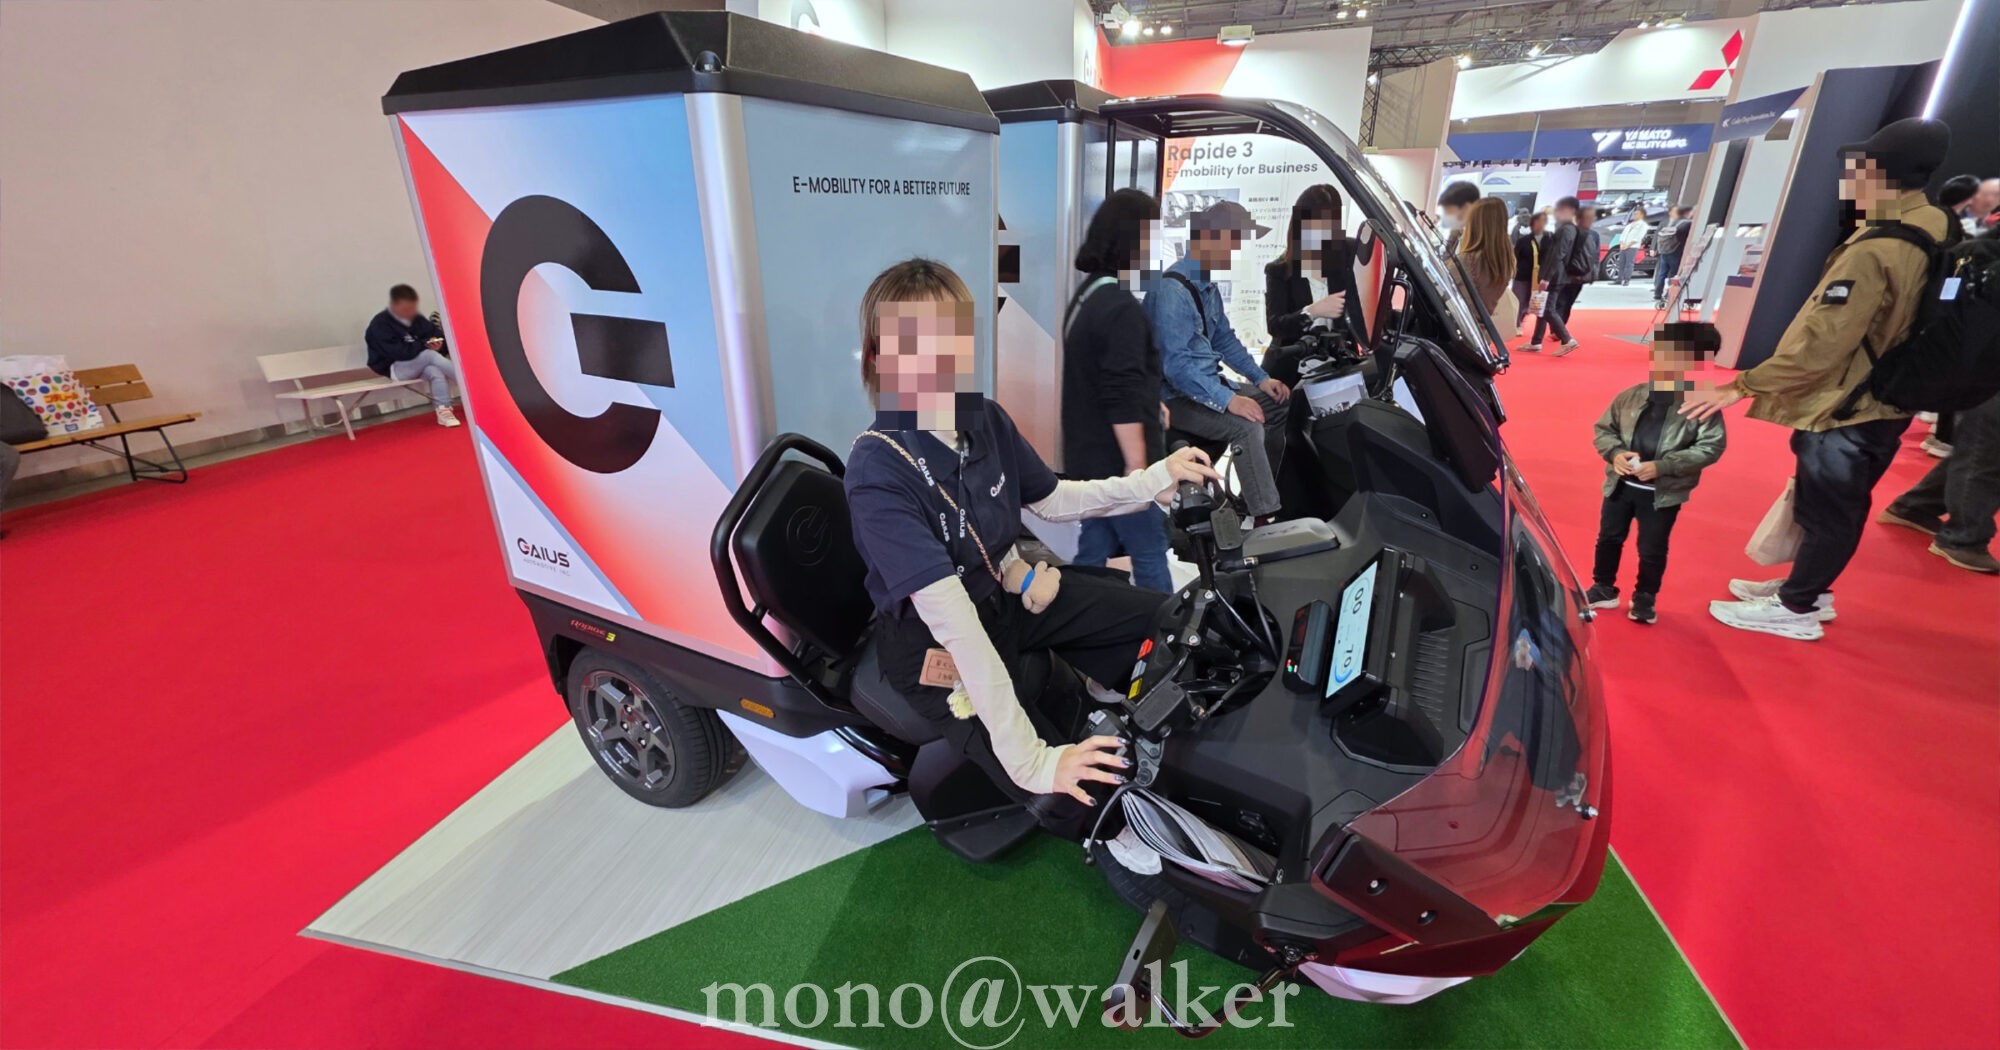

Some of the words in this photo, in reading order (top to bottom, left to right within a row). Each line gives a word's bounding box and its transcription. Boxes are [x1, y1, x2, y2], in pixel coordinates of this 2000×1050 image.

[1624, 128, 1672, 141] YAMATO
[1167, 142, 1236, 165] Rapide
[1242, 141, 1253, 157] 3
[1166, 165, 1235, 179] E-mobility
[1237, 163, 1255, 175] for
[1258, 162, 1318, 174] Business
[792, 176, 866, 194] E-MOBILITY
[869, 179, 890, 195] FOR
[893, 179, 900, 194] A
[903, 180, 937, 195] BETTER
[938, 181, 971, 196] FUTURE
[517, 537, 570, 568] GAIUS
[606, 632, 616, 642] 3
